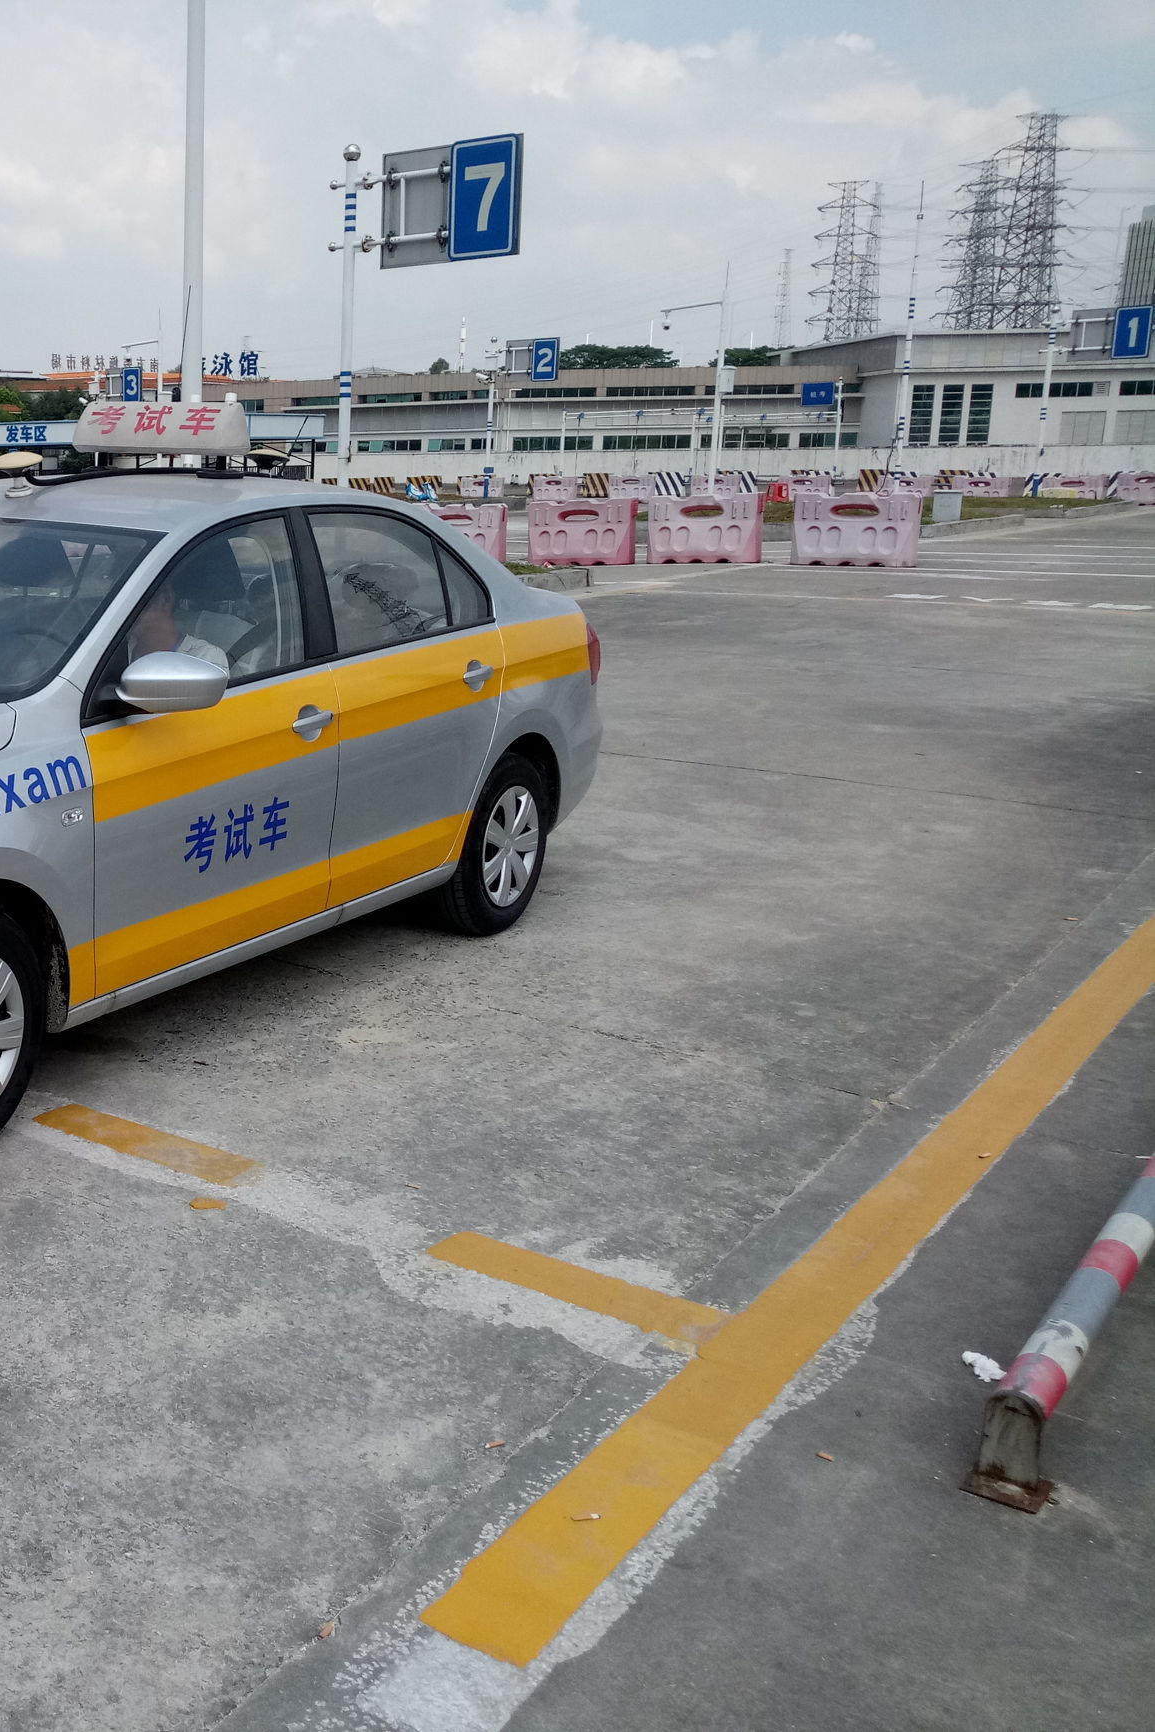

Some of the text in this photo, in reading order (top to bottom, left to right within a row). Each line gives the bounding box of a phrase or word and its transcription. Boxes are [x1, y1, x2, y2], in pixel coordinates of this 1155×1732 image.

[464, 161, 506, 232] 7
[1127, 316, 1140, 348] 1
[536, 347, 554, 373] 2
[126, 374, 138, 396] 3
[5, 425, 47, 443] 发车区
[87, 404, 221, 436] 考试车
[184, 796, 290, 874] 考试车
